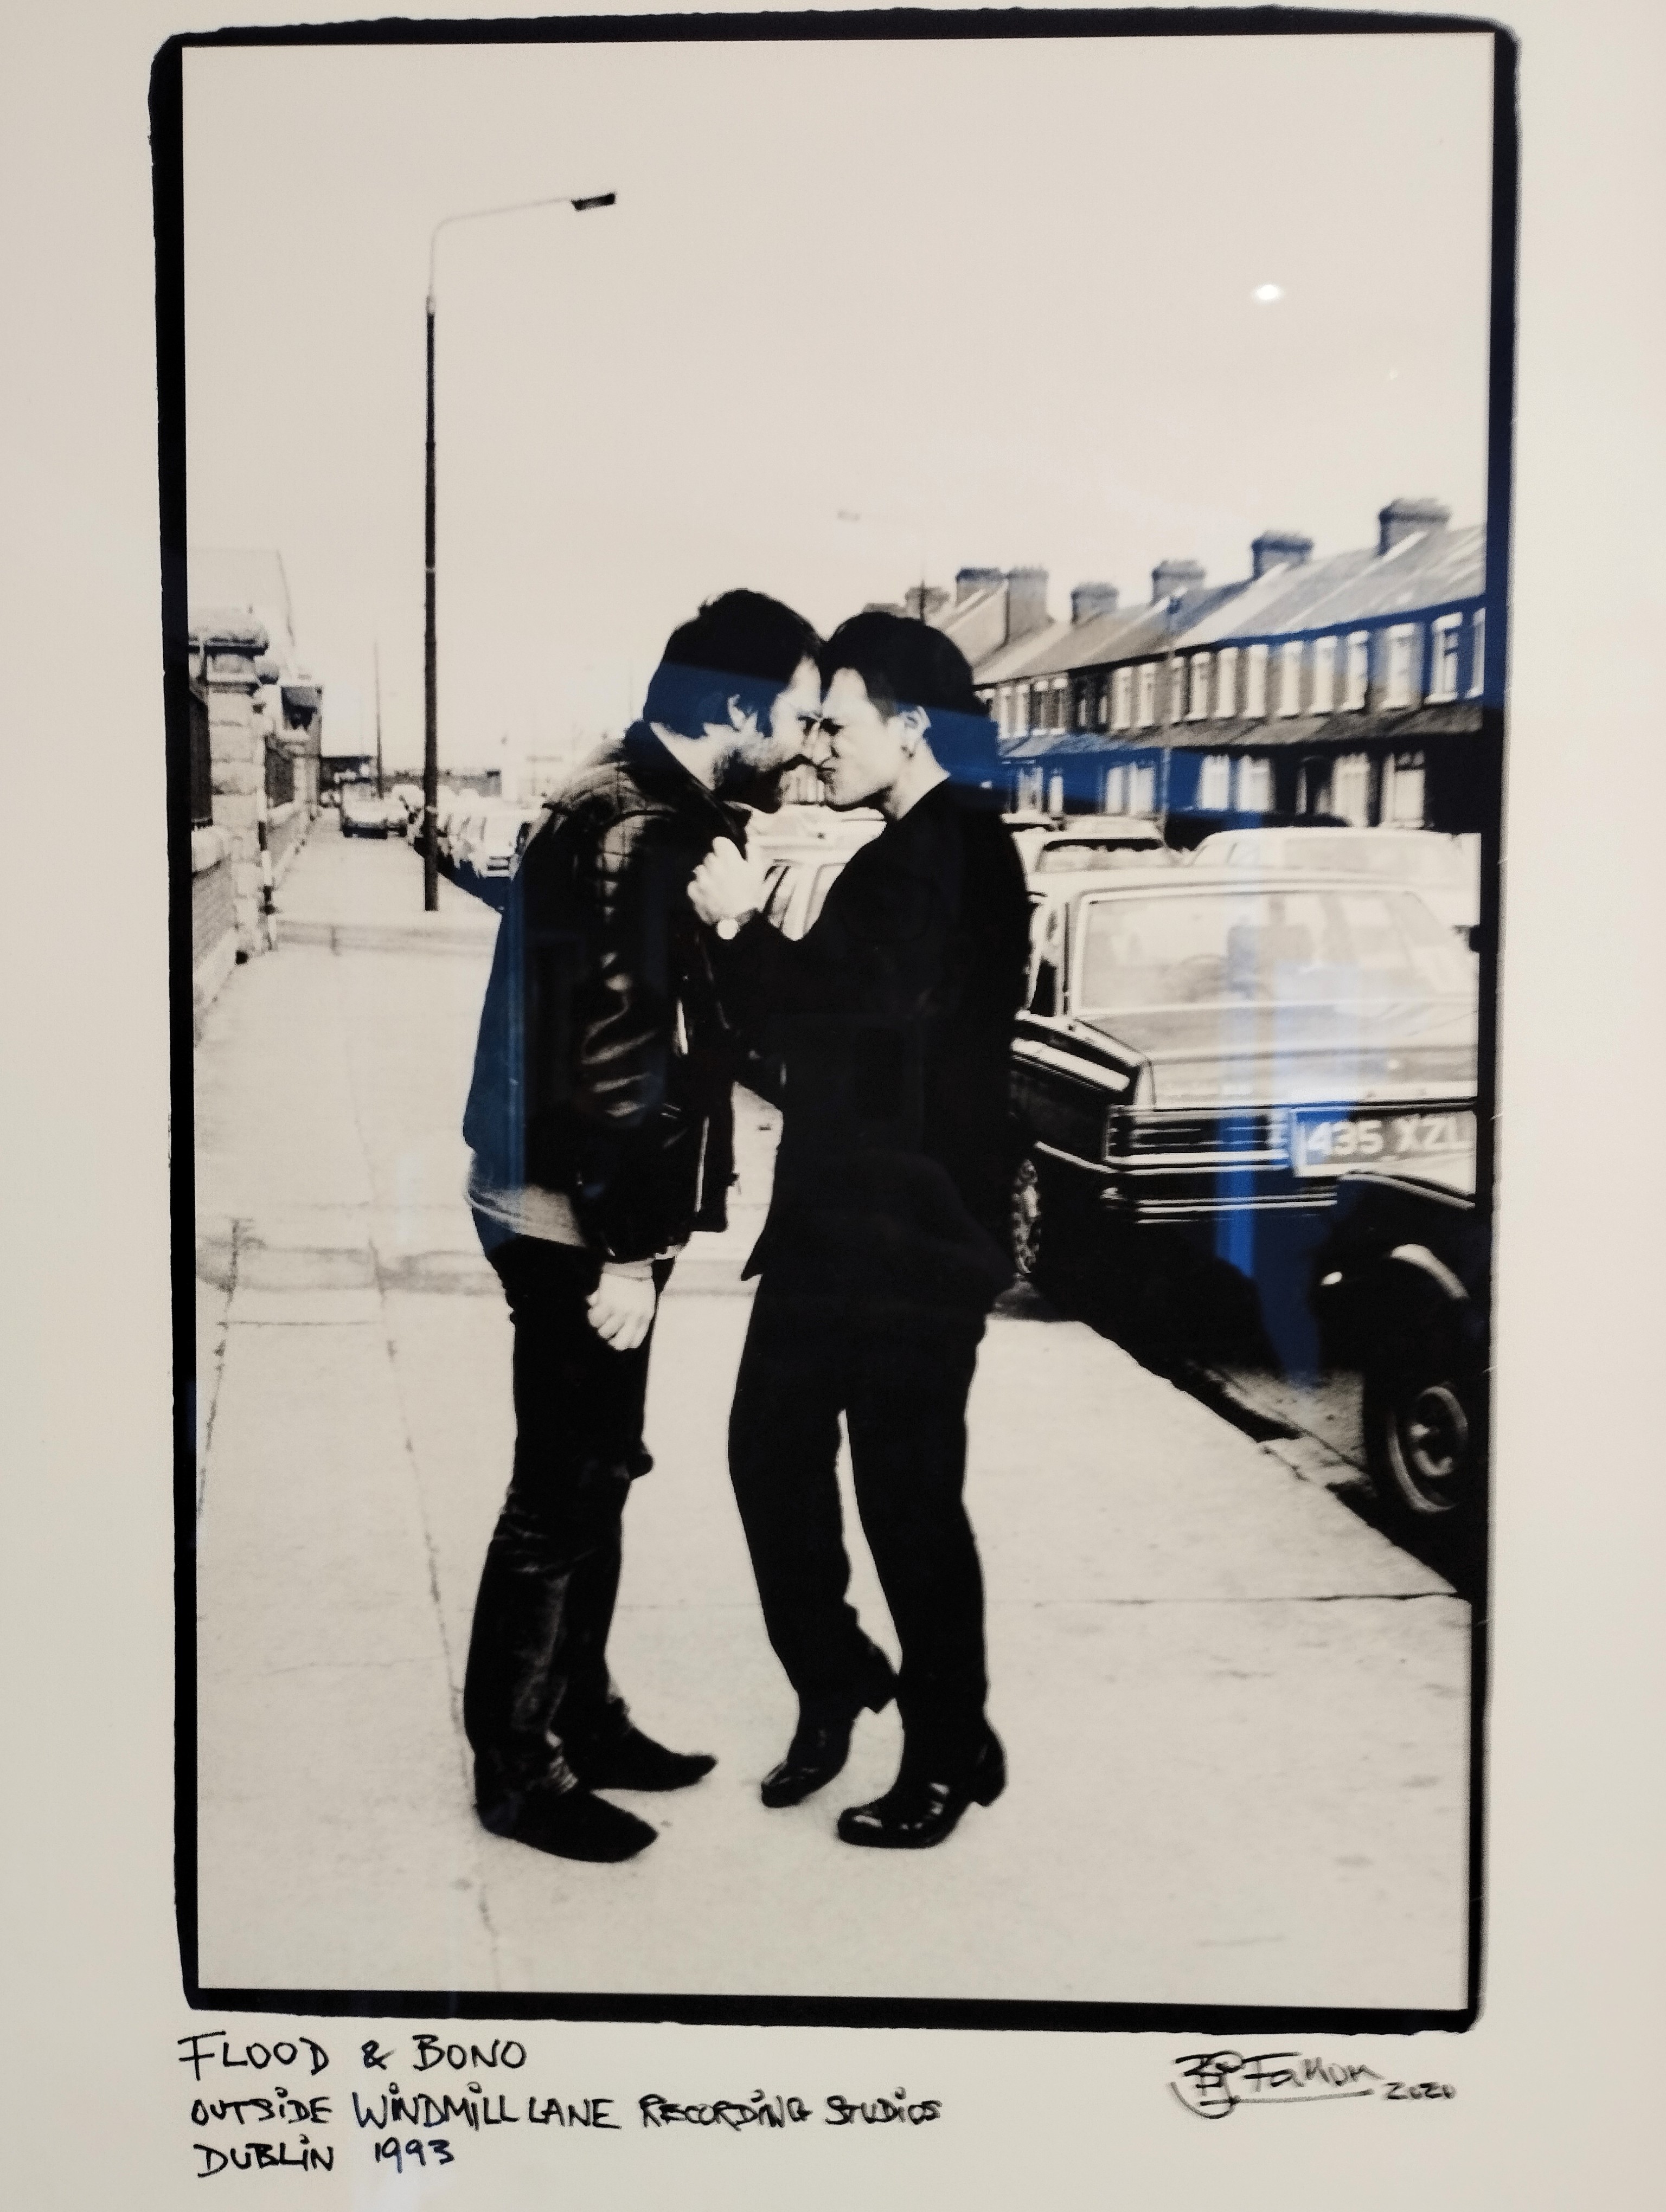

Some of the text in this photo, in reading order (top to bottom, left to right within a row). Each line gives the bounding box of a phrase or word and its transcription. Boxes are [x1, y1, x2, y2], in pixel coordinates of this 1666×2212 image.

[1307, 1119, 1384, 1156] 435
[177, 2030, 527, 2081] FLOOD & BONO
[528, 2096, 623, 2130] LANE
[374, 2137, 456, 2174] 1993
